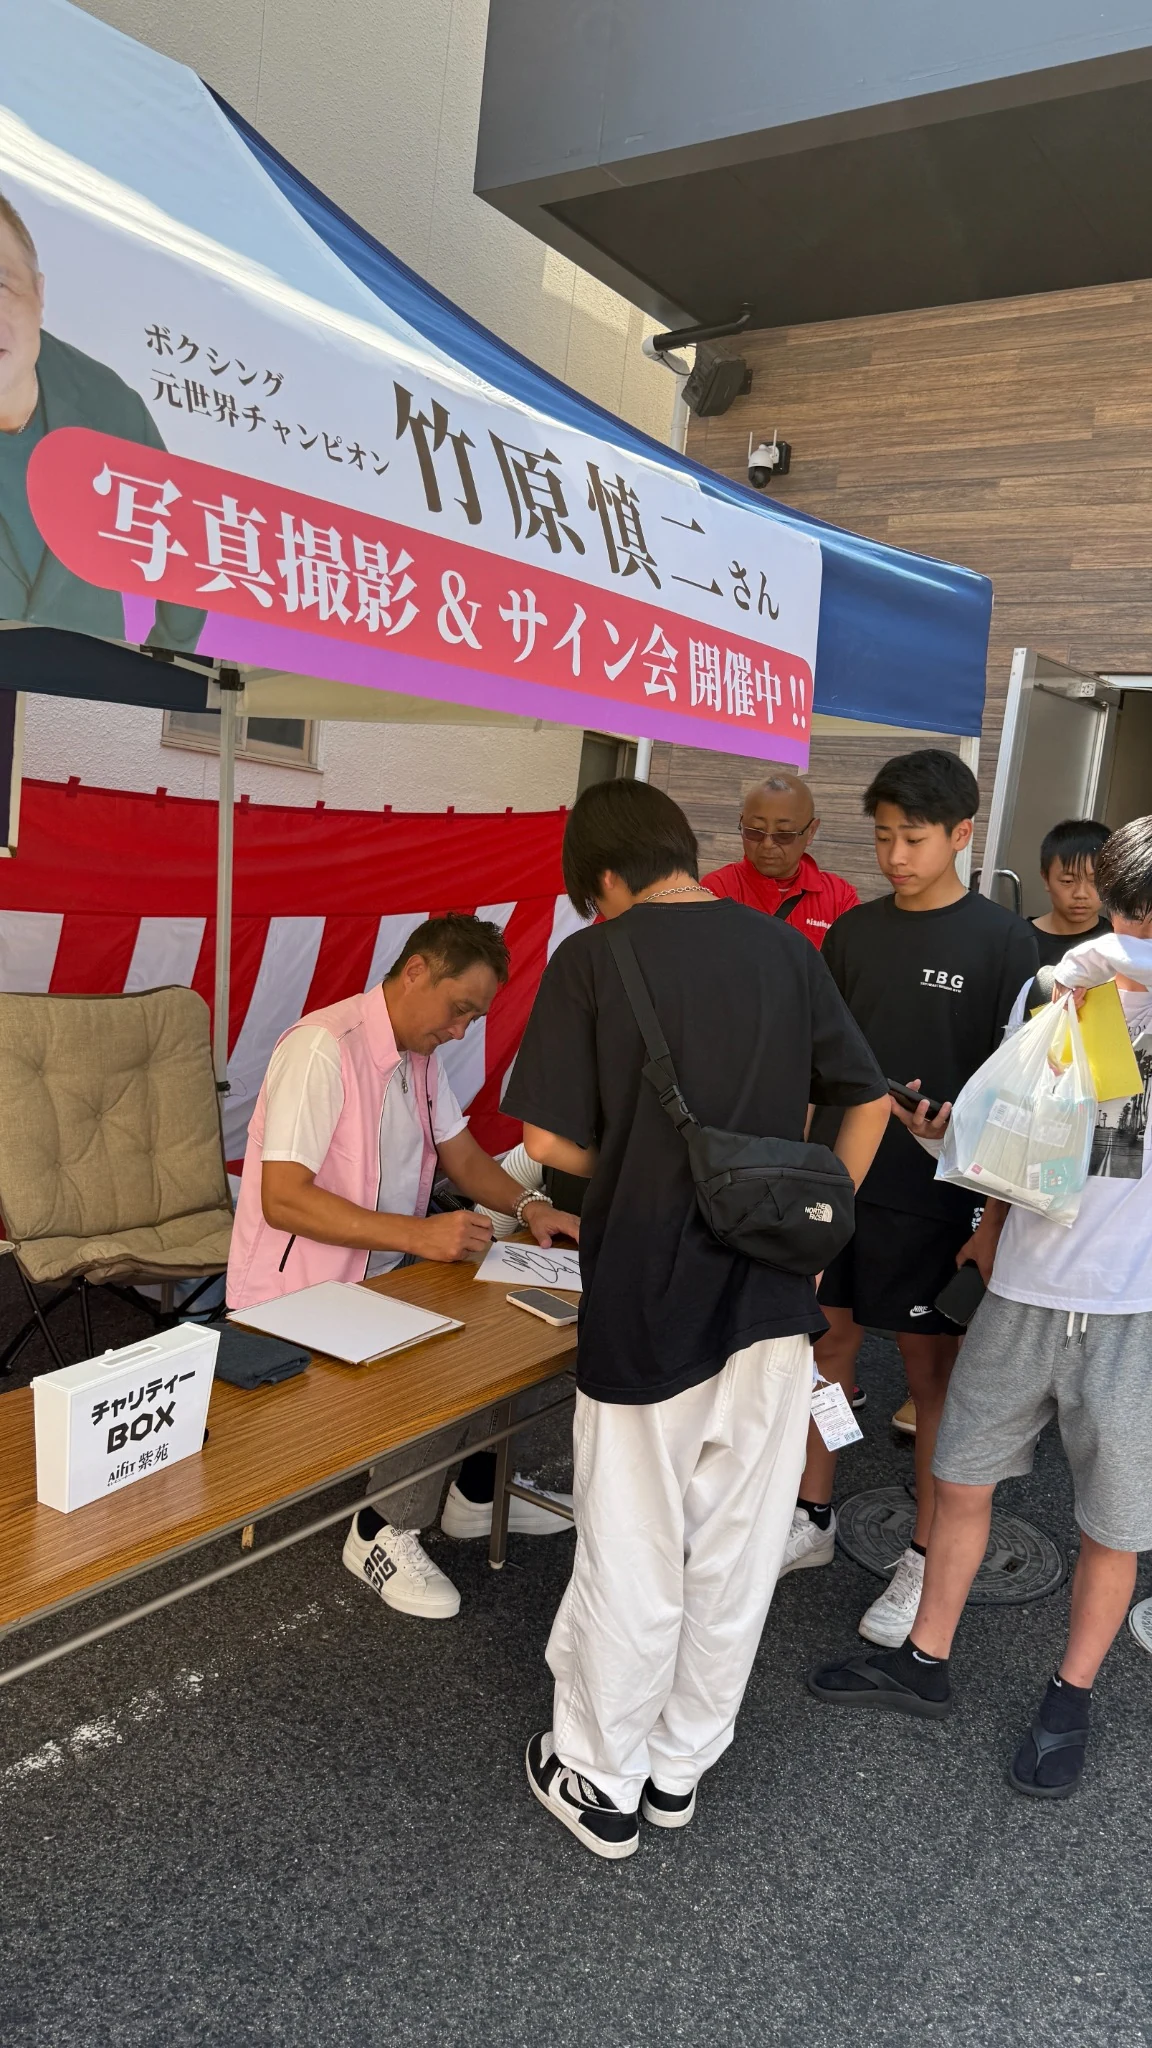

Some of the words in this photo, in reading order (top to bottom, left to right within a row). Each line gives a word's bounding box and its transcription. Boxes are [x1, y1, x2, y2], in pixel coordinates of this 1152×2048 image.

[144, 324, 285, 397] ボクシング
[150, 369, 390, 476] 元世界チャンピオン
[804, 1206, 825, 1215] NORTH
[809, 1213, 823, 1221] FACE
[91, 1371, 196, 1426] チャリティー
[107, 1401, 176, 1454] BOX
[138, 1443, 169, 1472] 紫苑
